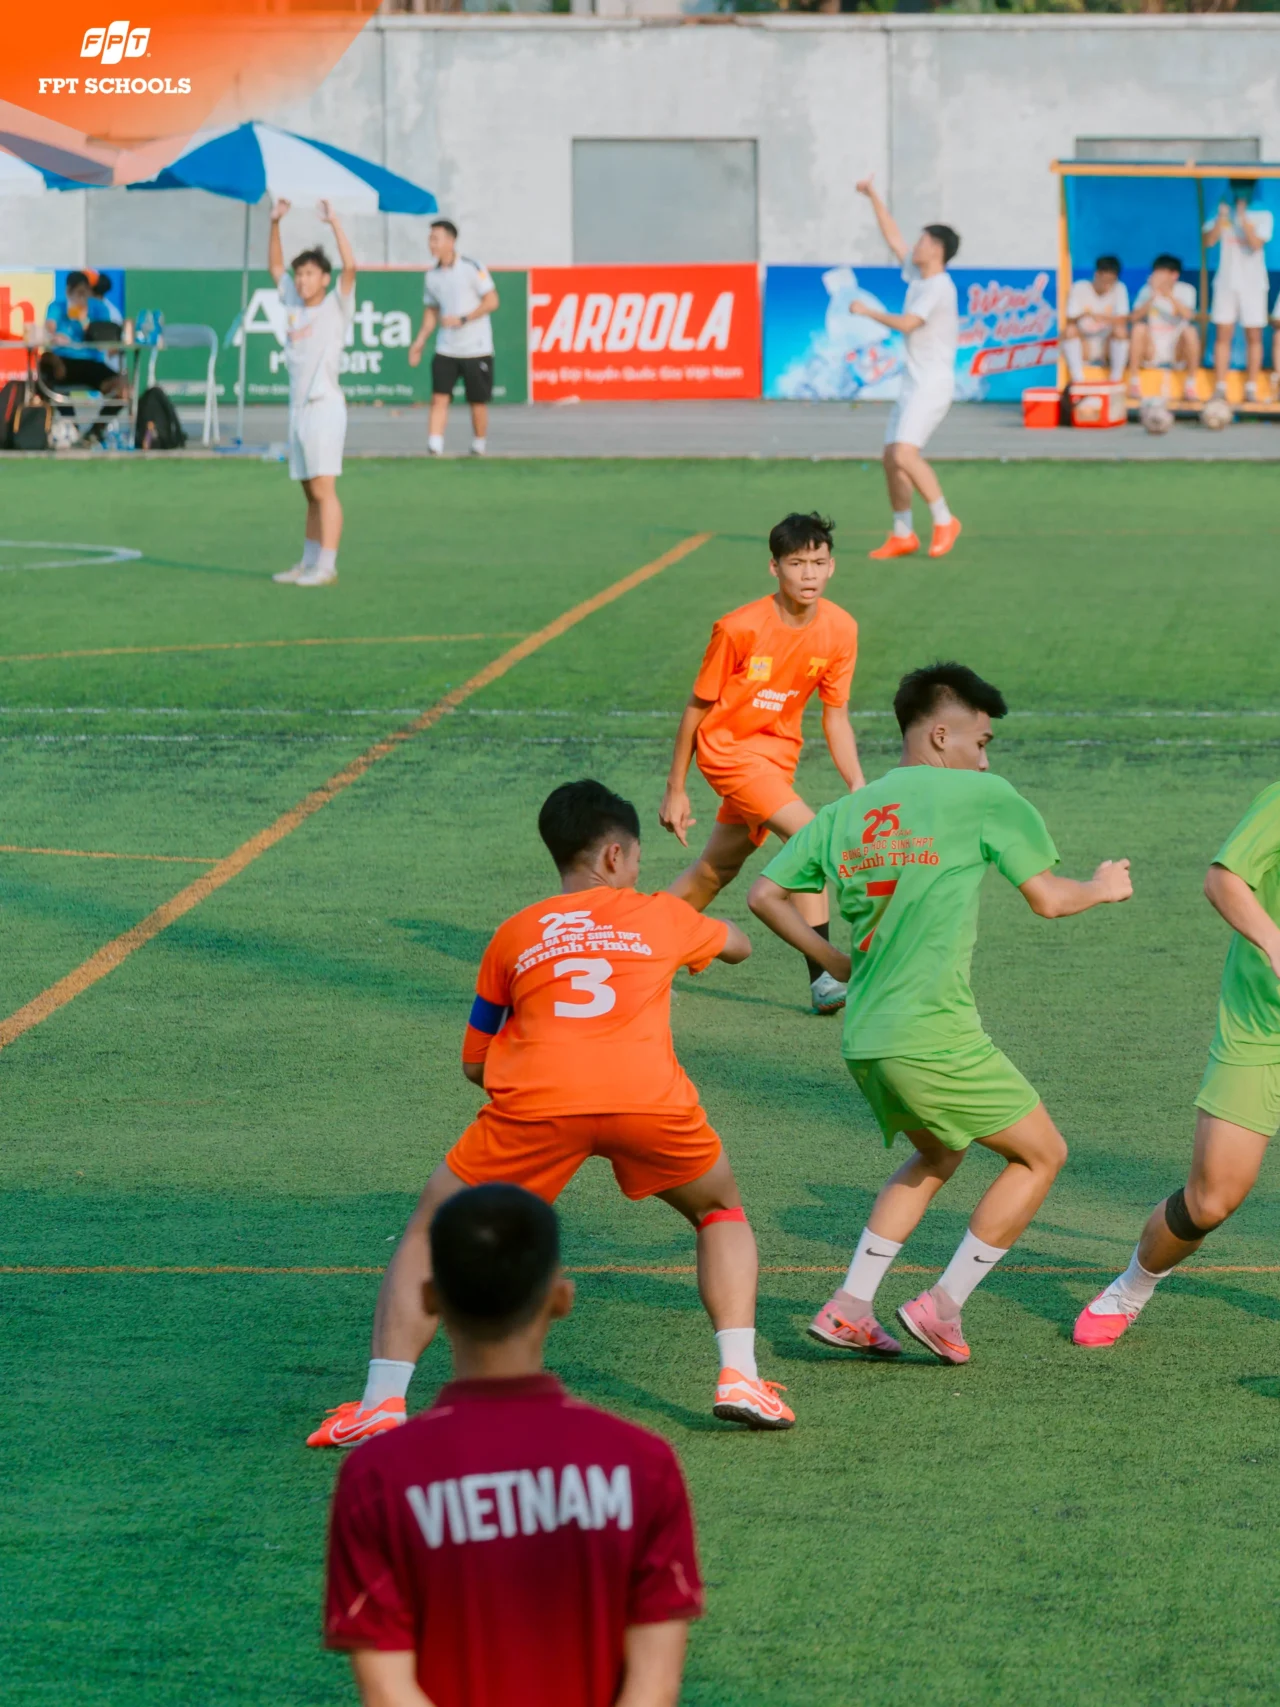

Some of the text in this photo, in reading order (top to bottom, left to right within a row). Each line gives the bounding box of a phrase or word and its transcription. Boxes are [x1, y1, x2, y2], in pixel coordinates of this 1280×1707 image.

[863, 803, 901, 844] 25
[538, 910, 596, 941] 25
[553, 957, 616, 1019] 3
[405, 1464, 633, 1549] VIETNAM
